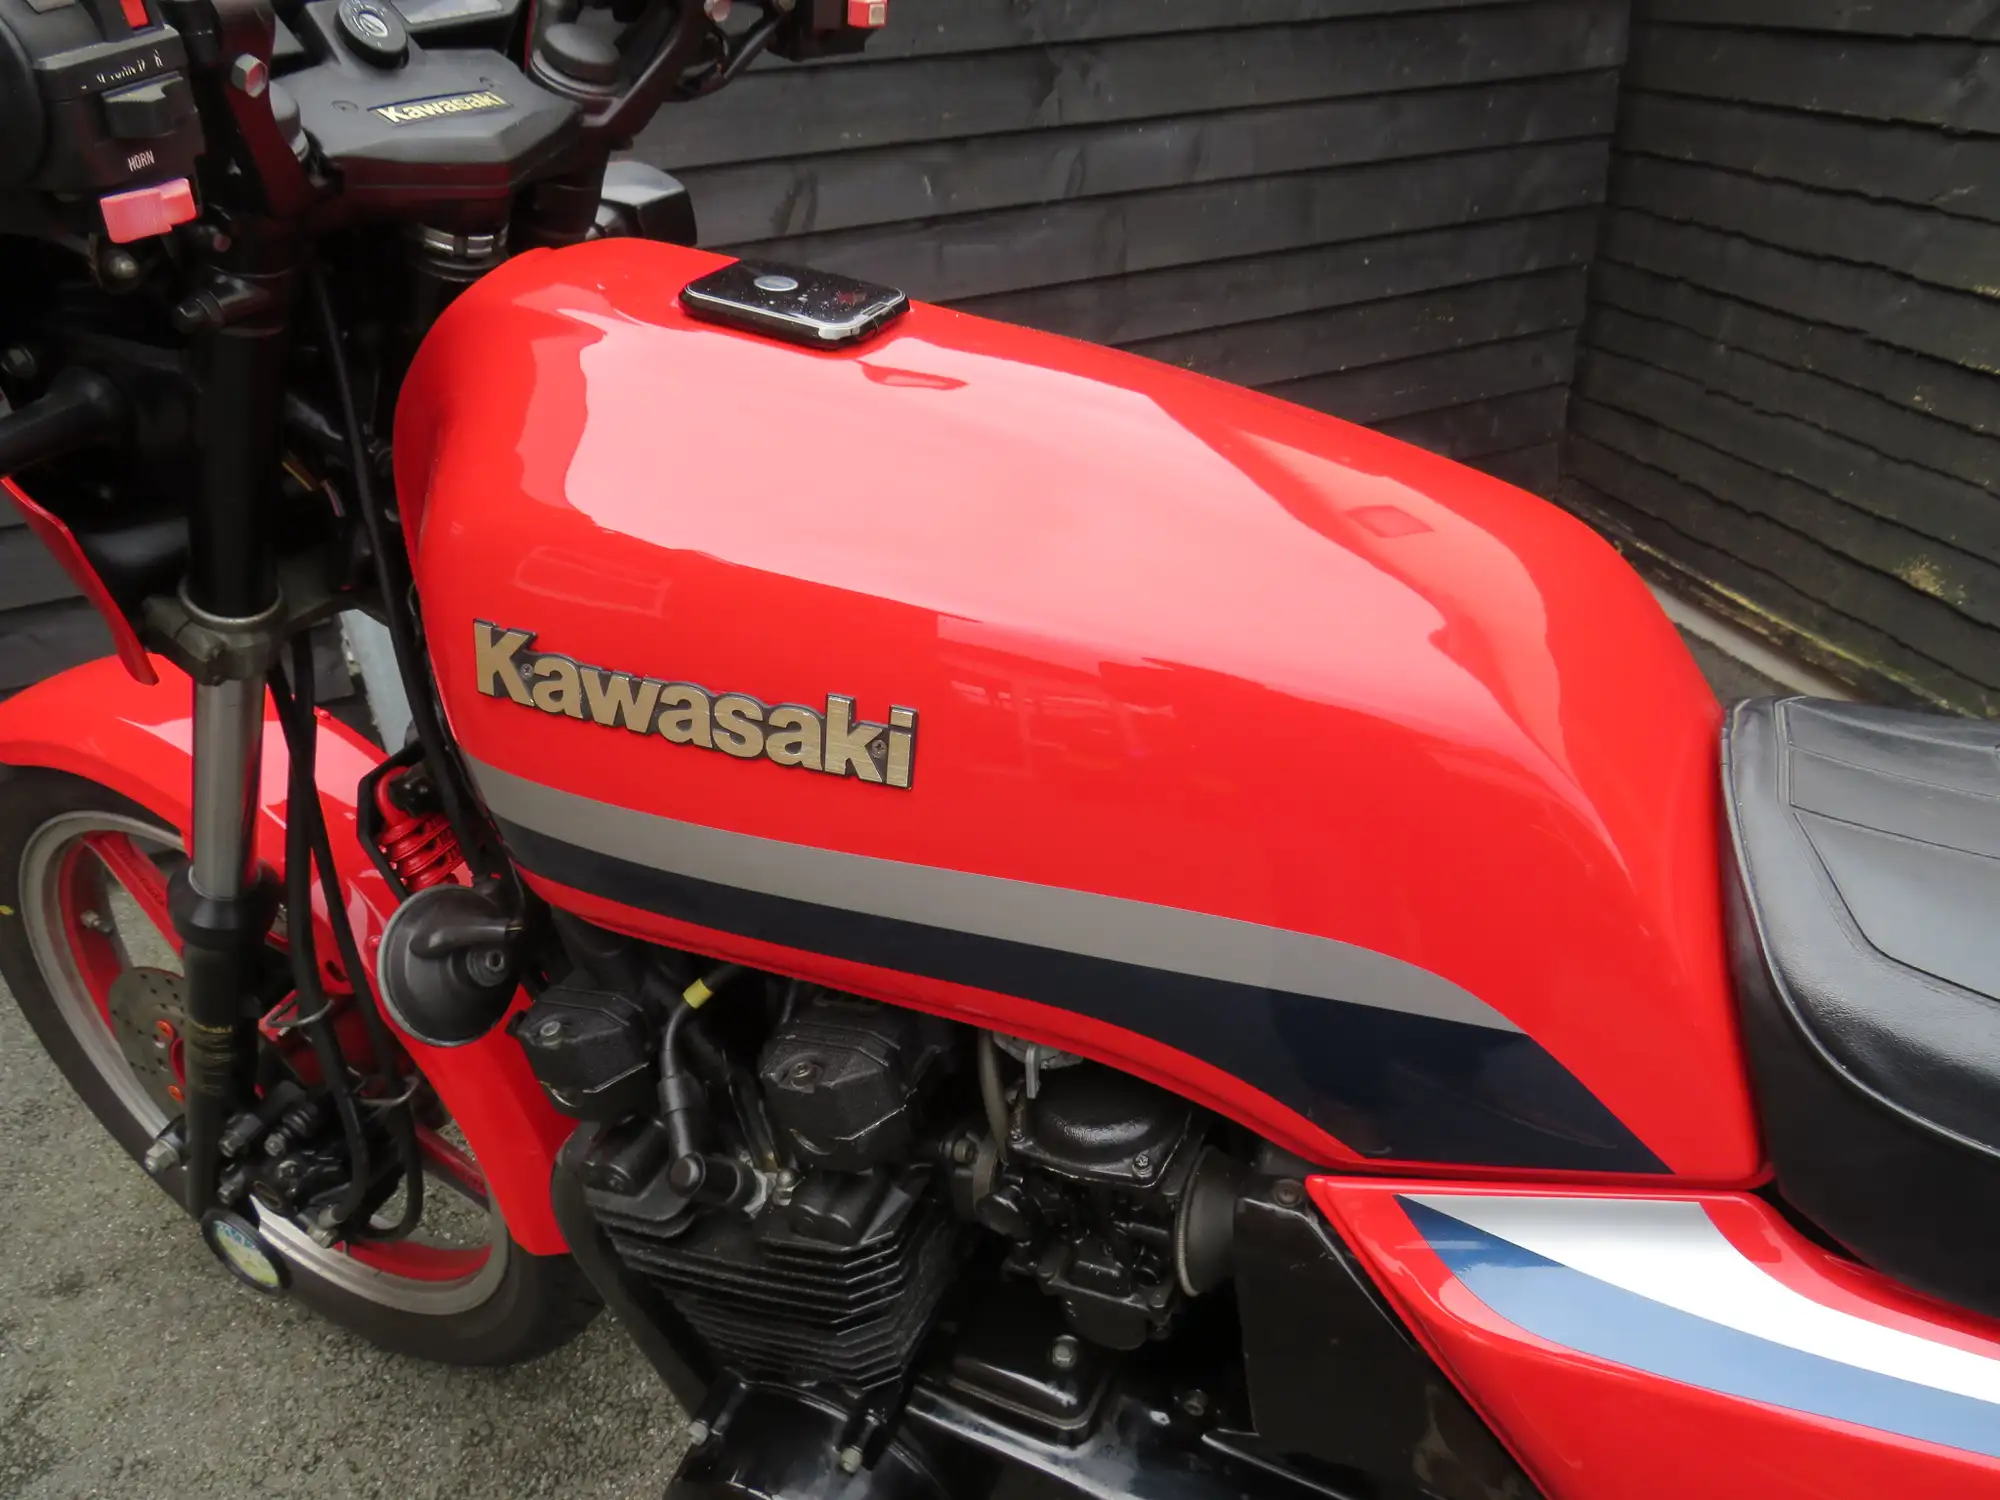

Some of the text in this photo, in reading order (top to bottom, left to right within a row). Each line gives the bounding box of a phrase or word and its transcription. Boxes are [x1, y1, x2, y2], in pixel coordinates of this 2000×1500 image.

[377, 91, 506, 123] Kawasaki
[127, 149, 155, 172] HORN
[473, 619, 918, 789] Kawasaki
